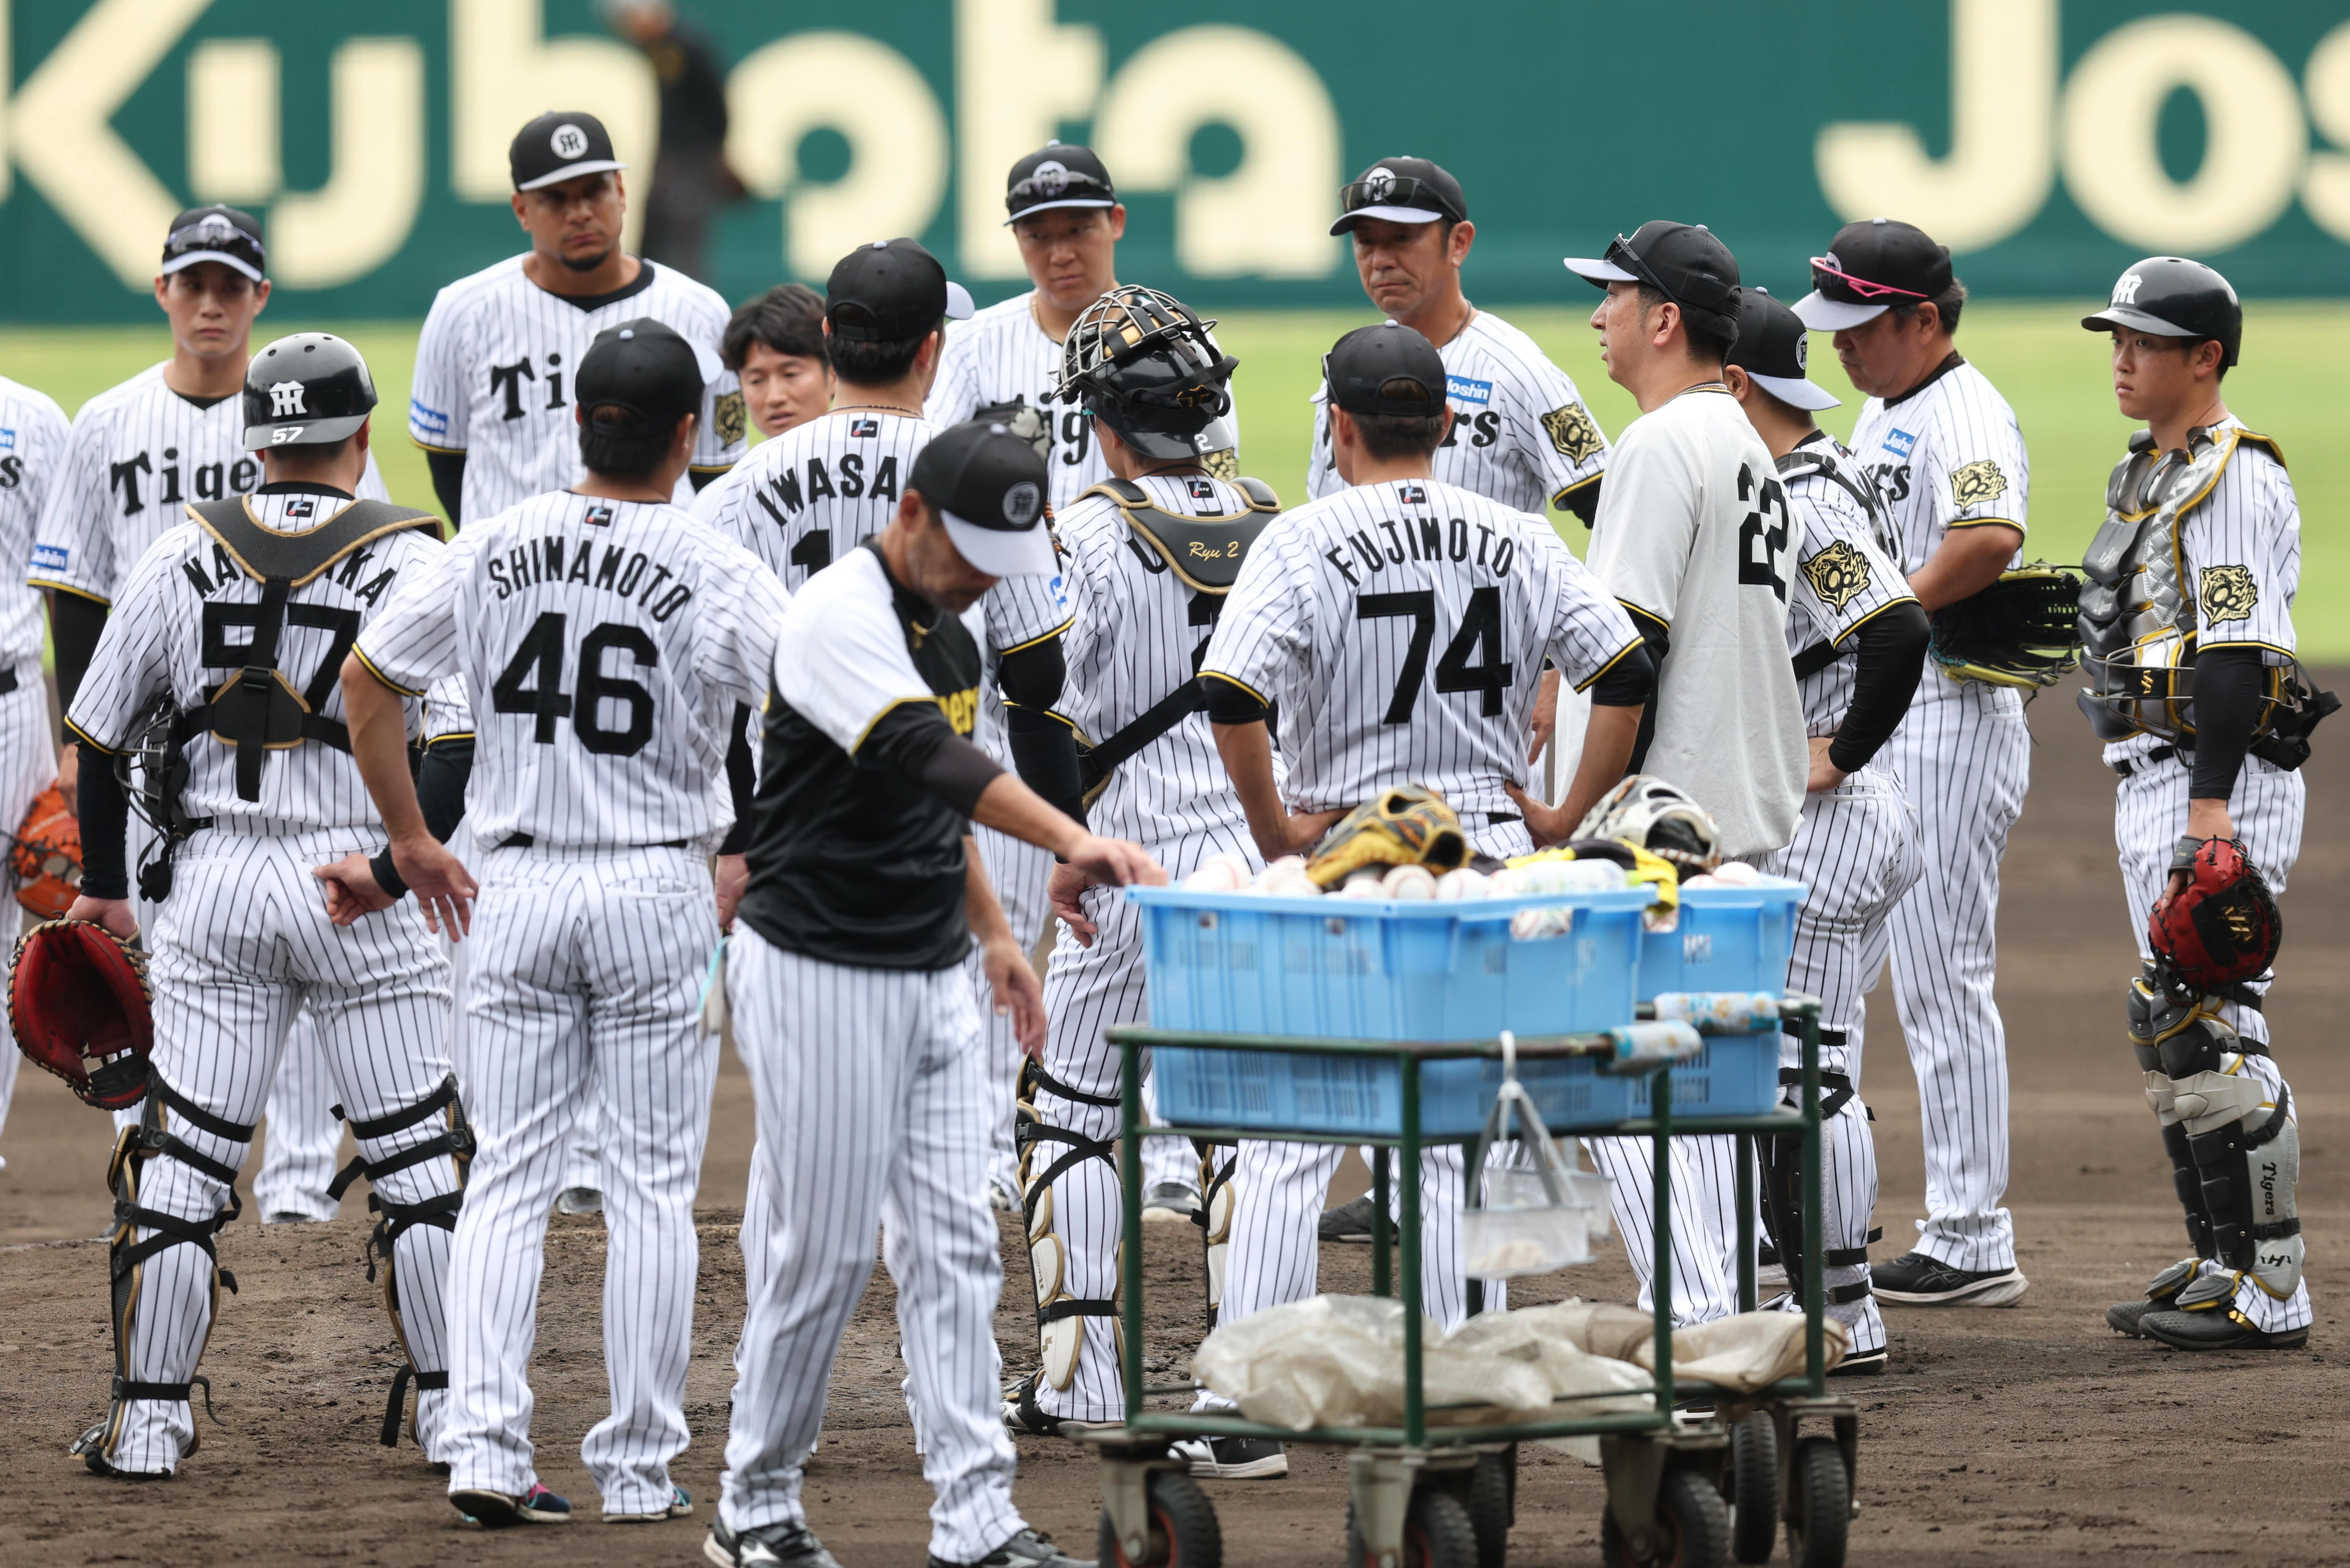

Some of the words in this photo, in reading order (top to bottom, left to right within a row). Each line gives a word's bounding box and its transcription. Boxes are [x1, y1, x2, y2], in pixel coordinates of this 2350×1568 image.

[1814, 0, 2350, 255] Jo
[271, 427, 304, 444] 57
[1194, 433, 1214, 452] 2
[110, 447, 258, 516] Tige
[489, 536, 692, 622] SHIMAMOTO
[1189, 541, 1222, 562] Ryu
[1227, 541, 1239, 558] 2
[1325, 517, 1514, 587] FUJIMOTO
[1847, 580, 1868, 594] Tigers
[492, 611, 657, 757] 46
[1356, 587, 1512, 724] 74
[2259, 1161, 2278, 1216] Tigers
